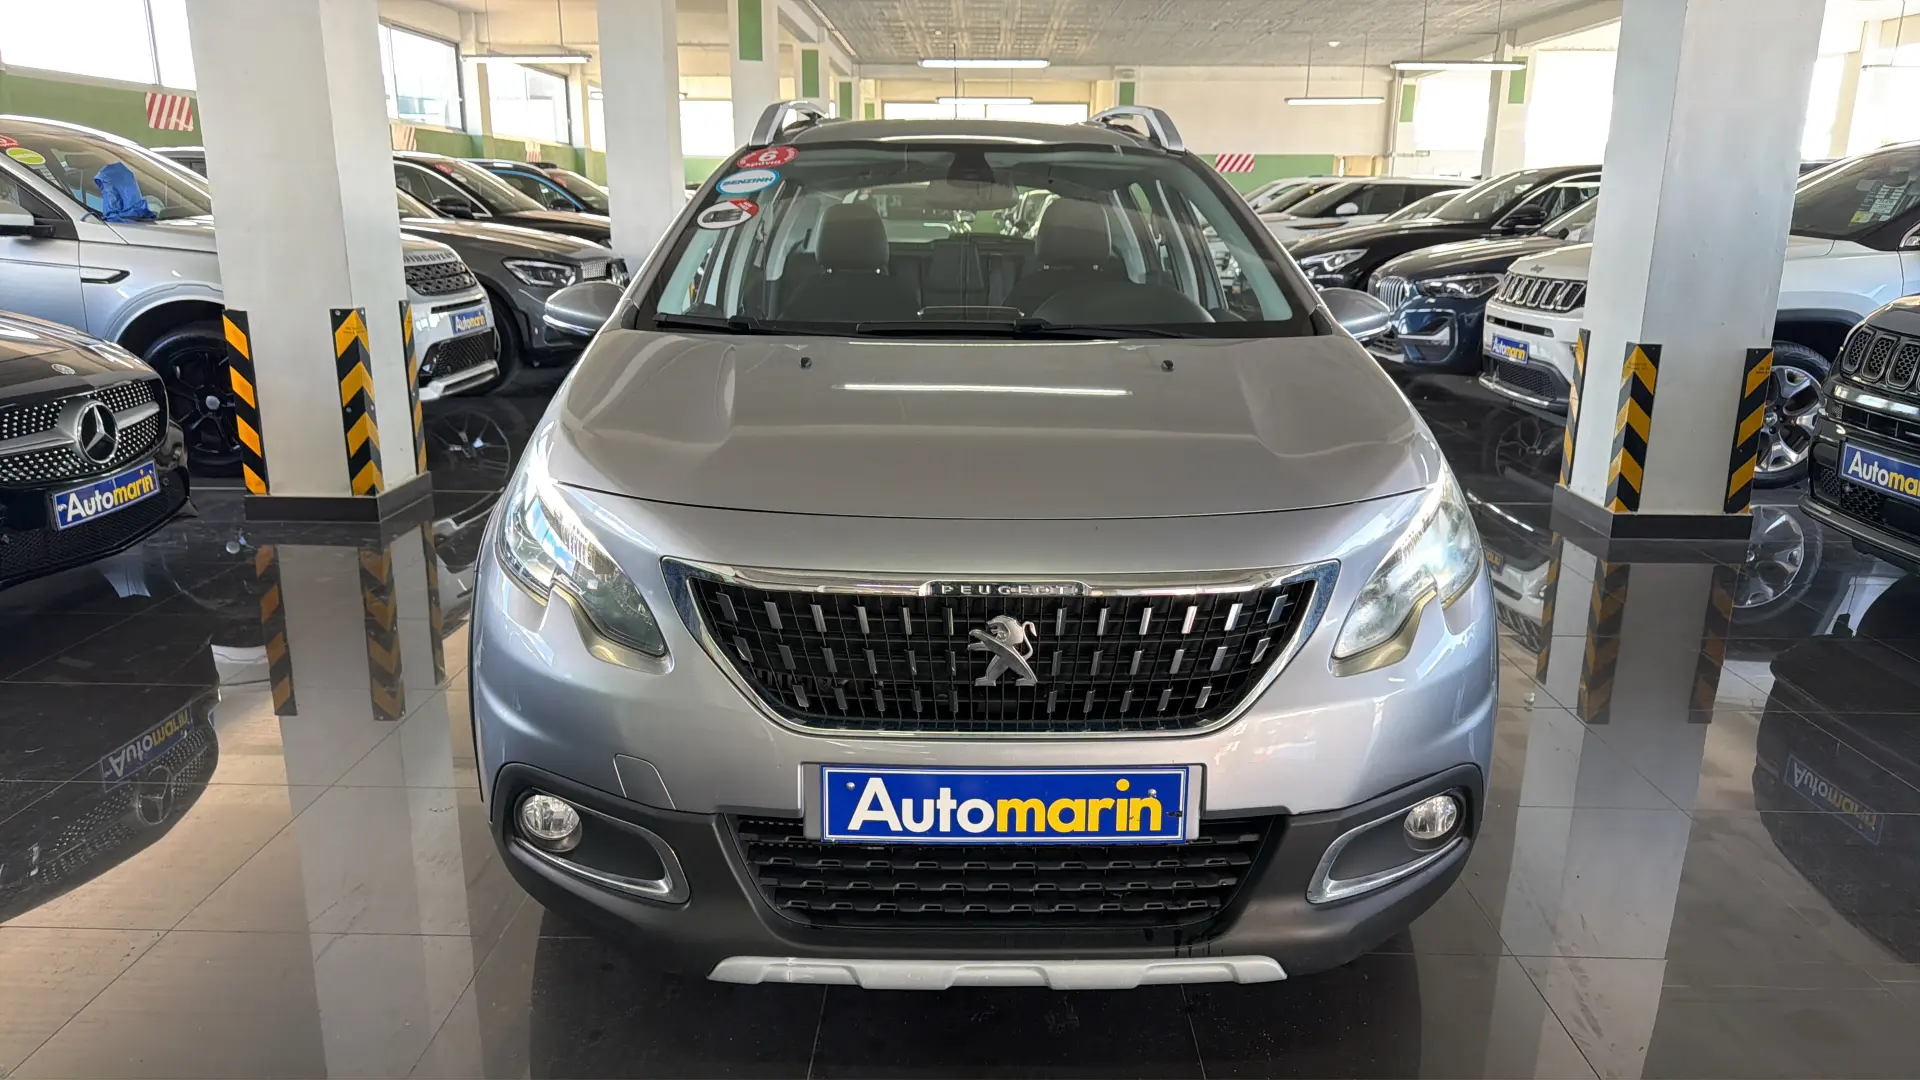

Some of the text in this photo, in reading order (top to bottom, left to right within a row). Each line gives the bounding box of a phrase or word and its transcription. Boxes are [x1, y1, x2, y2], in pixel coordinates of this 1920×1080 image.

[759, 150, 779, 162] 6
[66, 469, 154, 522] Automarin
[1848, 451, 1920, 497] Automa
[941, 585, 1069, 595] PEUGEOT
[847, 777, 1162, 834] Automarin
